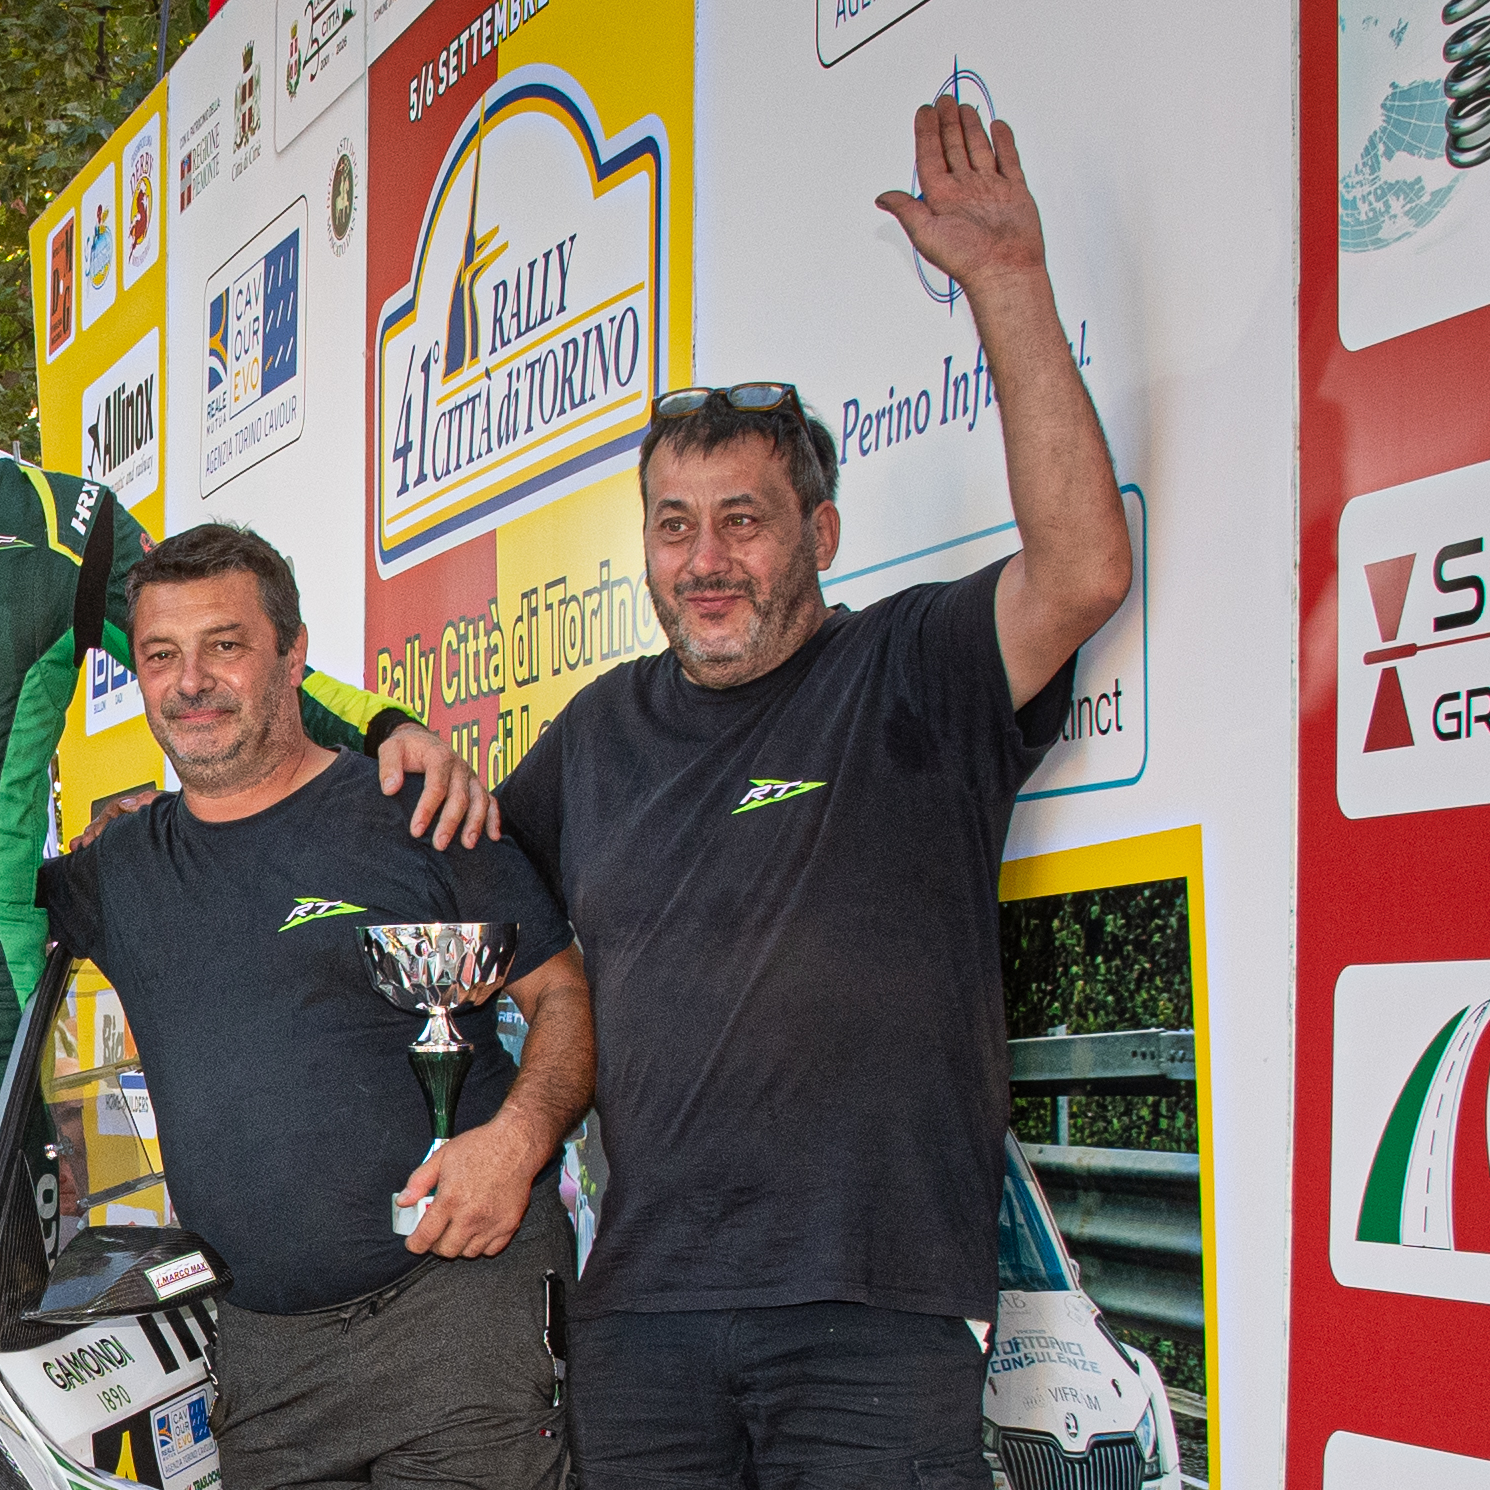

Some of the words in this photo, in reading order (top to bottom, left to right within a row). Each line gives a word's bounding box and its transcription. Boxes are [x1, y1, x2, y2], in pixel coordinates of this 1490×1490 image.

[408, 59, 436, 123] 5/6
[235, 271, 262, 322] CAV
[488, 233, 577, 357] RALLY
[234, 316, 260, 362] OUR
[234, 356, 260, 403] EVO
[432, 367, 494, 483] CITTÀ
[496, 358, 520, 442] di
[523, 306, 640, 435] TORINO
[102, 372, 154, 477] Allinox
[206, 390, 227, 422] REALE
[391, 340, 440, 498] 41°
[840, 386, 930, 466] Perino
[206, 442, 233, 478] AGENZIA
[234, 418, 261, 458] TORINO
[263, 395, 297, 438] CAVOUR
[71, 479, 101, 536] HRX
[377, 632, 436, 727] Rally
[440, 596, 506, 709] Città
[511, 587, 539, 689] di
[544, 559, 660, 676] Torino
[740, 779, 803, 805] RT
[286, 899, 343, 921] RT
[191, 1261, 206, 1275] MAX
[42, 1335, 136, 1392] GAMONDI
[97, 1385, 131, 1412] 1890
[173, 1409, 187, 1424] CAV
[175, 1421, 190, 1436] OUR
[178, 1433, 193, 1449] EVO
